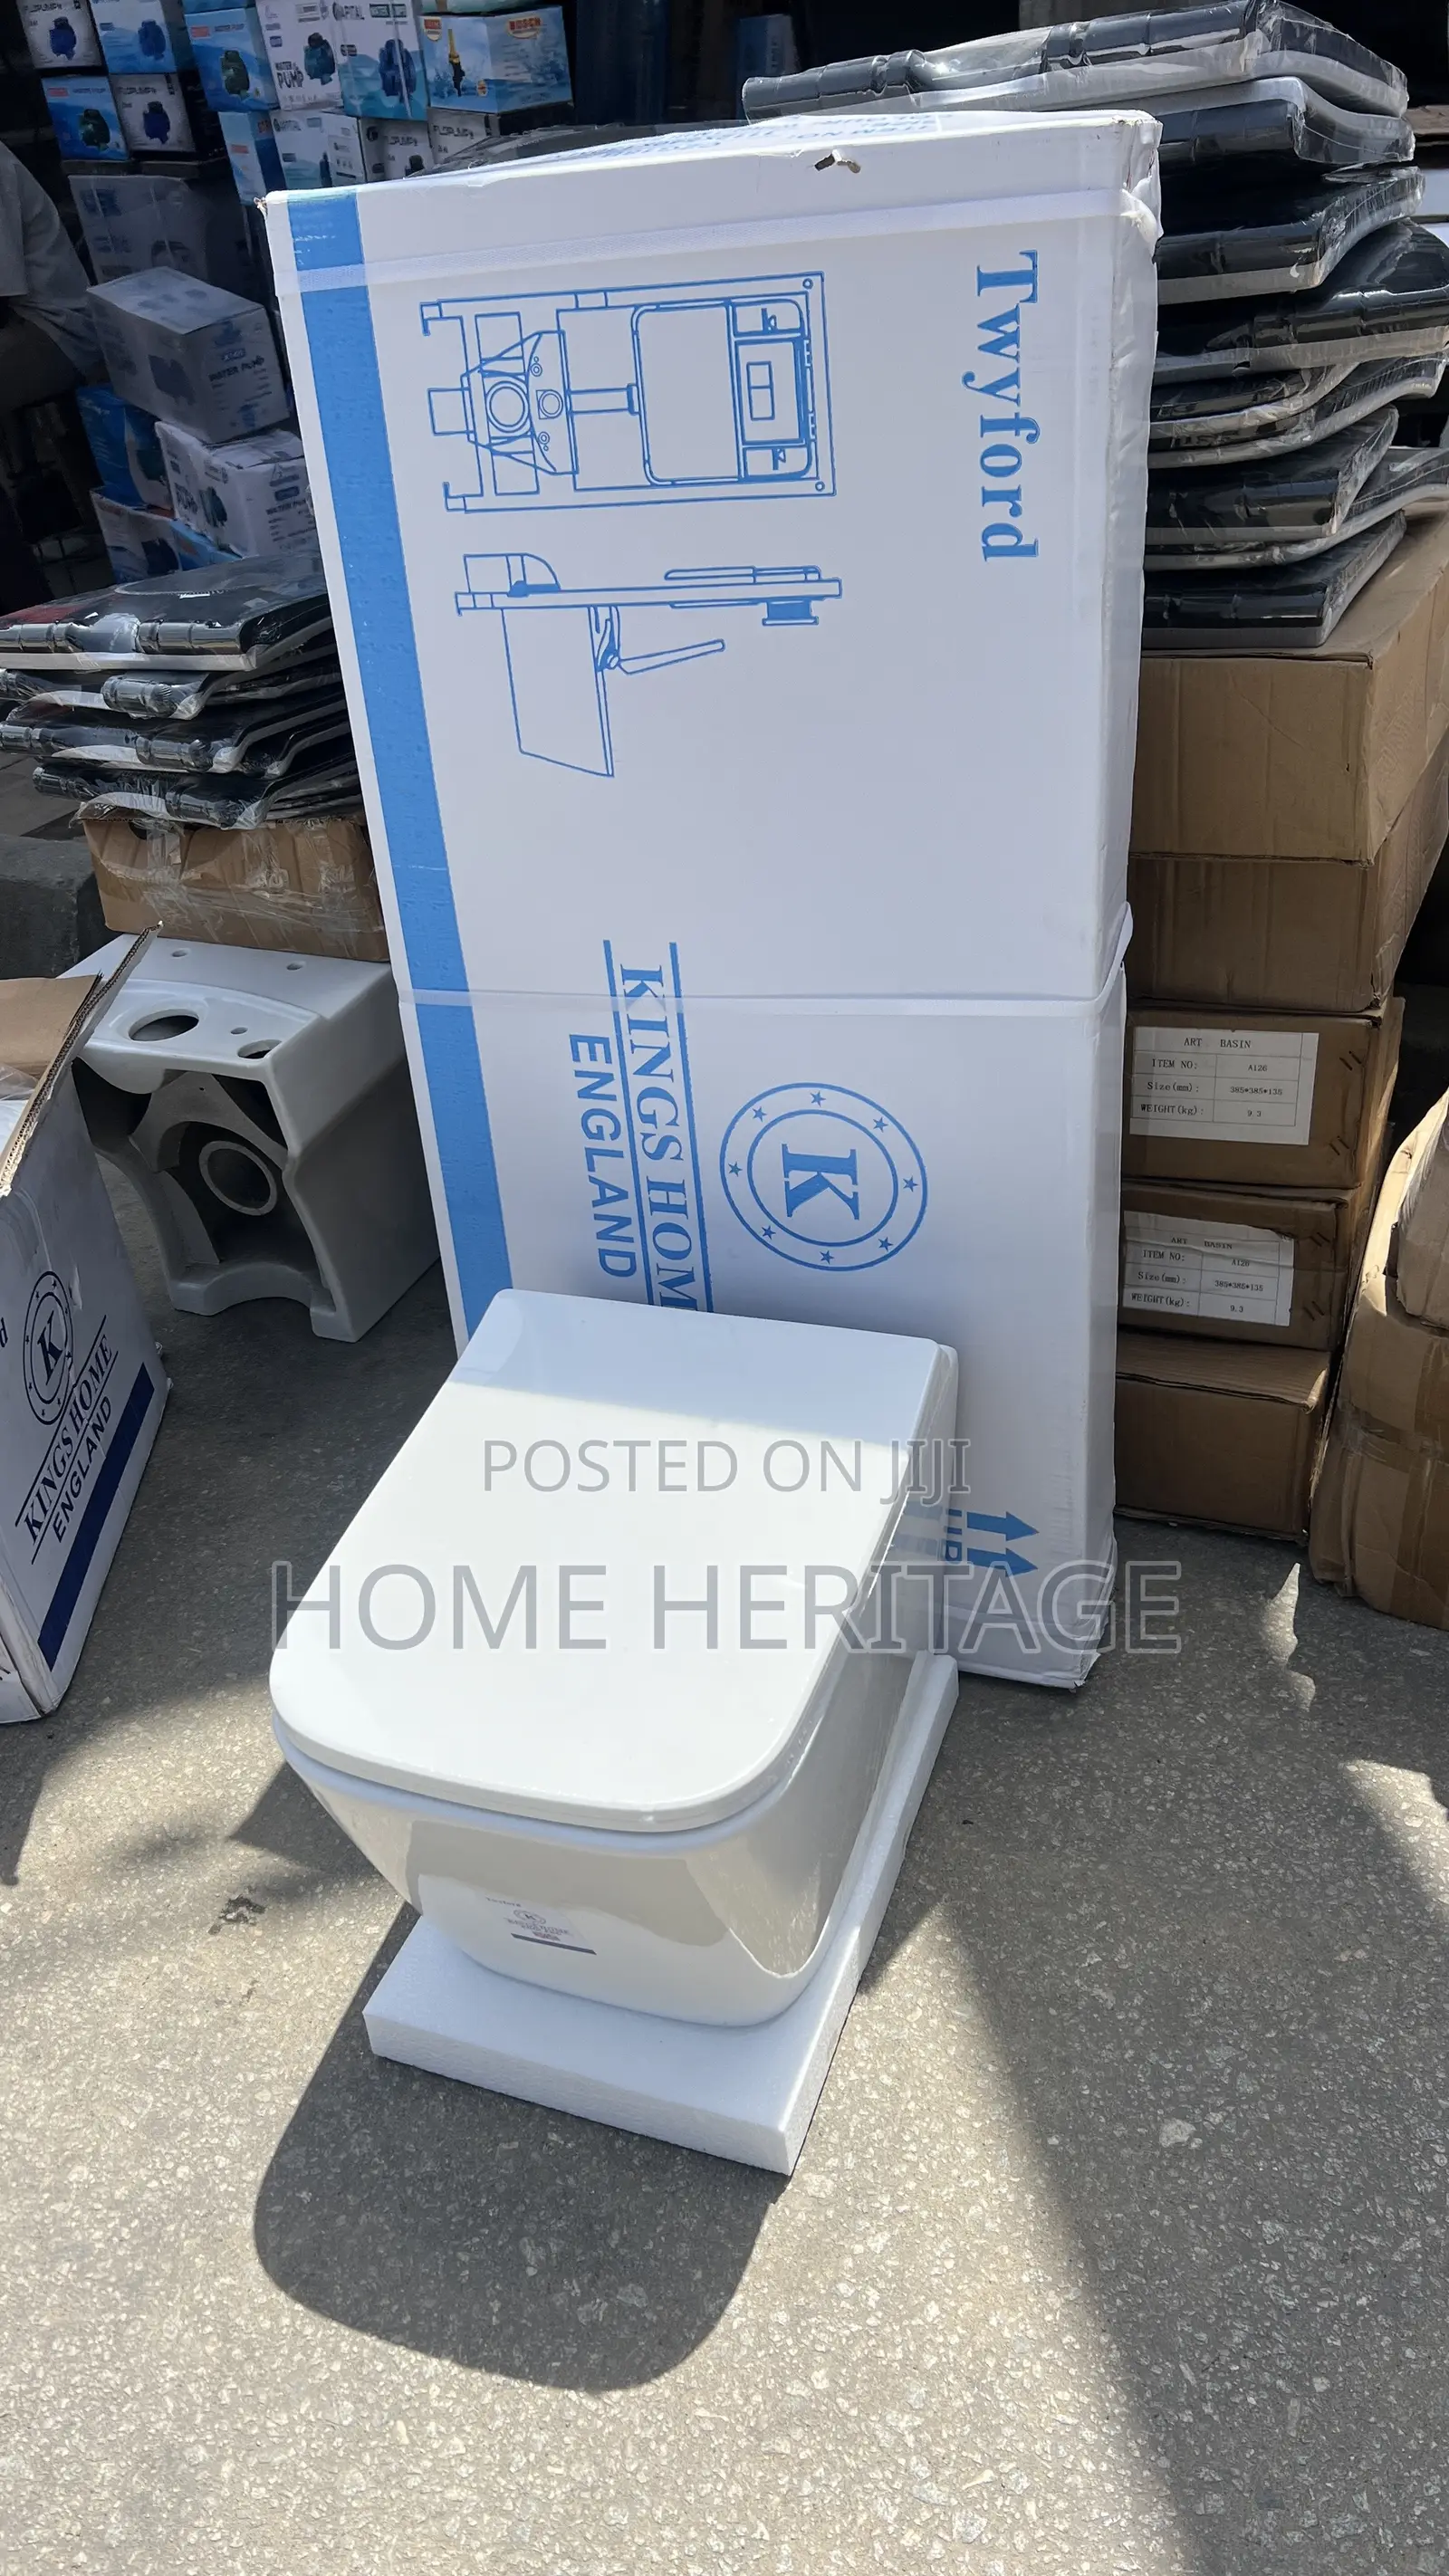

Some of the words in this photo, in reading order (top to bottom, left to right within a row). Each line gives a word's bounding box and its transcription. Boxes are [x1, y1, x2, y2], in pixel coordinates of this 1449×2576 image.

[962, 249, 1040, 562] Twyford
[620, 963, 685, 1162] KINGS
[1152, 1058, 1175, 1068] ITEM
[1181, 1060, 1197, 1069] NO:
[1184, 1038, 1203, 1047] ART
[1220, 1039, 1251, 1049] BASIN
[1248, 1064, 1268, 1072] A126
[569, 1033, 638, 1278] ENGLAND
[781, 1143, 860, 1221] K
[646, 1175, 699, 1311] HOM
[1143, 1250, 1165, 1259] ITEM
[1169, 1251, 1185, 1261] NO:
[1171, 1236, 1188, 1245] ART
[1204, 1240, 1233, 1250] BASIN
[1230, 1304, 1243, 1313] 9.3
[36, 1310, 63, 1385] K
[24, 1426, 74, 1546] KINGS
[69, 1334, 113, 1434] HOME
[52, 1395, 112, 1544] ENGLAND
